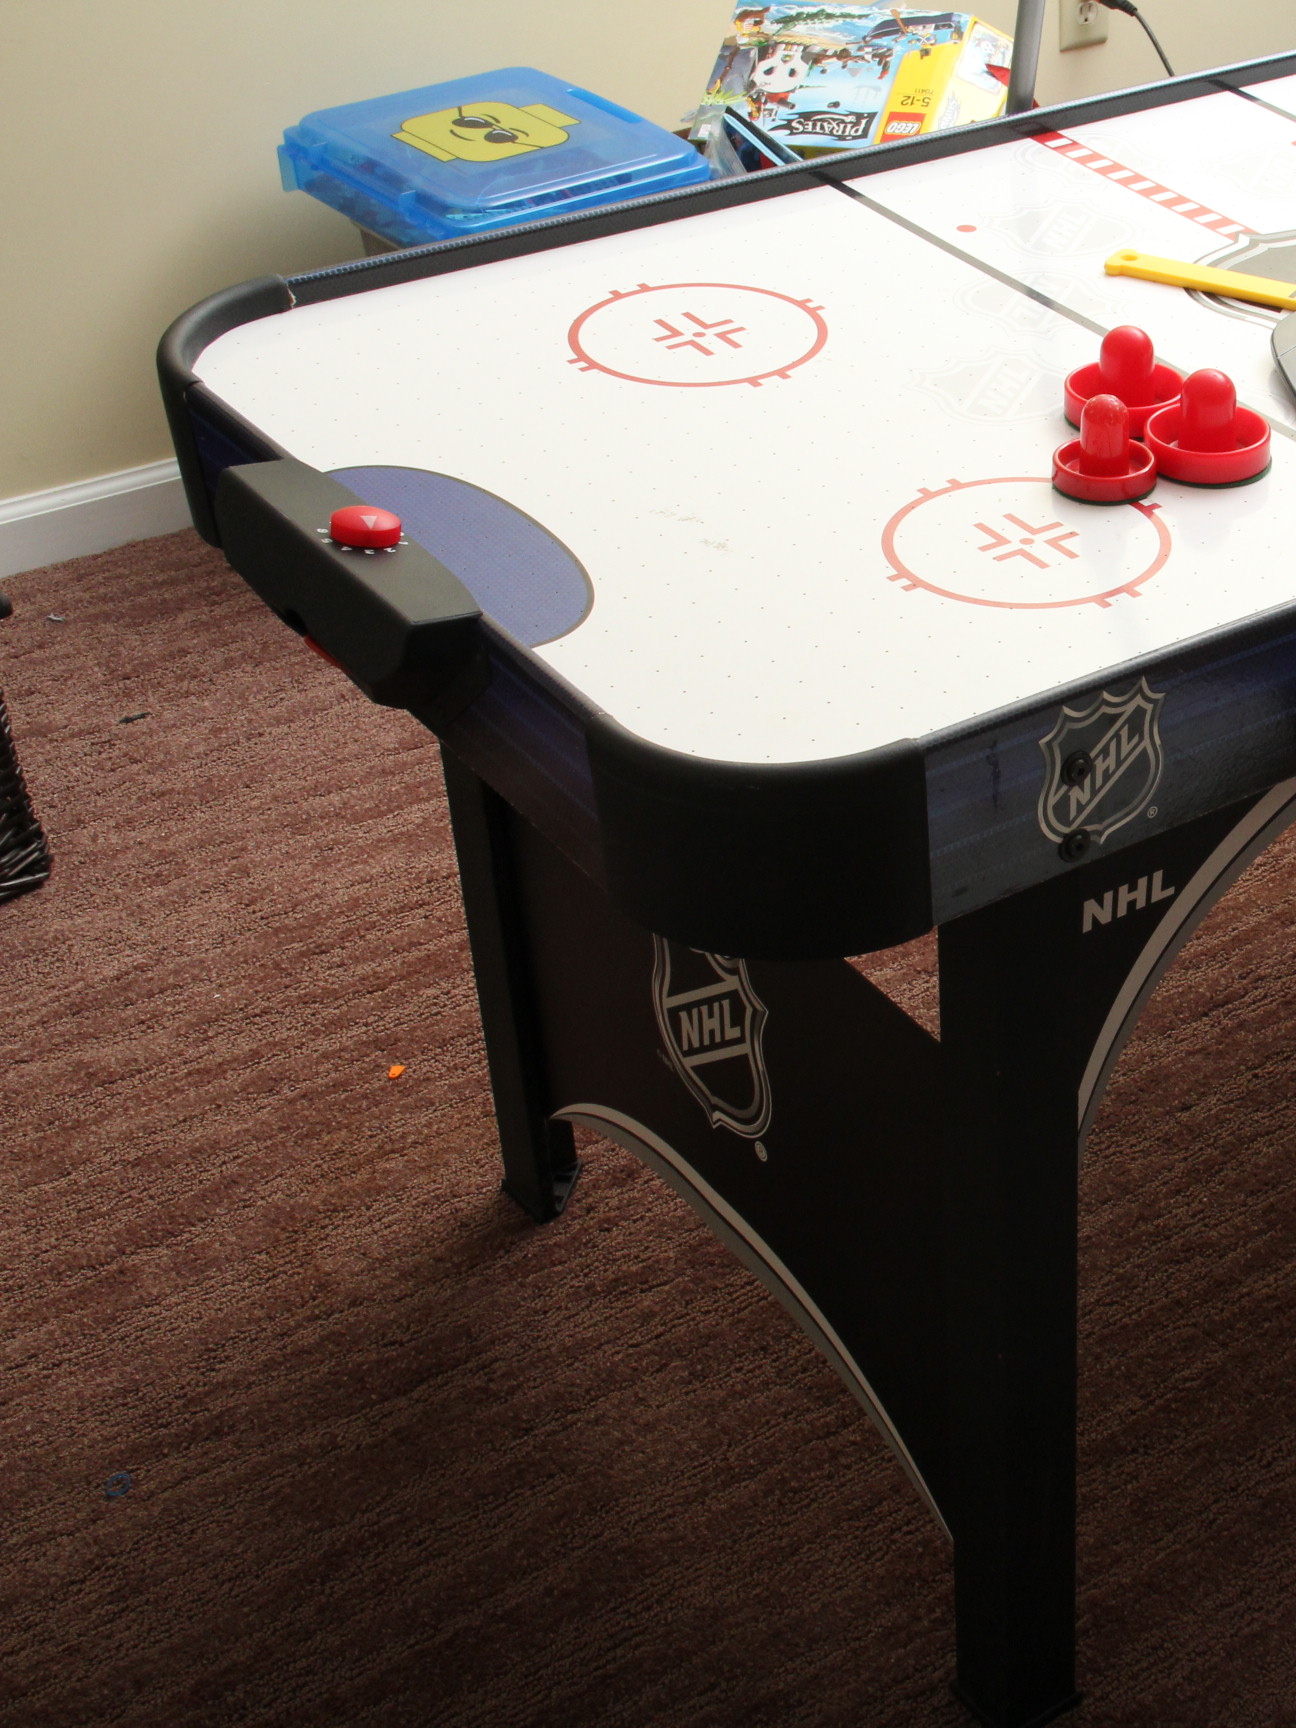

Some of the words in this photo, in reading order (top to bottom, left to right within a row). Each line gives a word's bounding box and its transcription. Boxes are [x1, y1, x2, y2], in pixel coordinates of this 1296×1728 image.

[900, 95, 931, 107] 5-12
[791, 116, 870, 136] PIRATES
[886, 121, 920, 135] LEGO
[1068, 724, 1139, 821] NHL
[1082, 869, 1176, 934] NHL
[678, 999, 741, 1051] NHL
